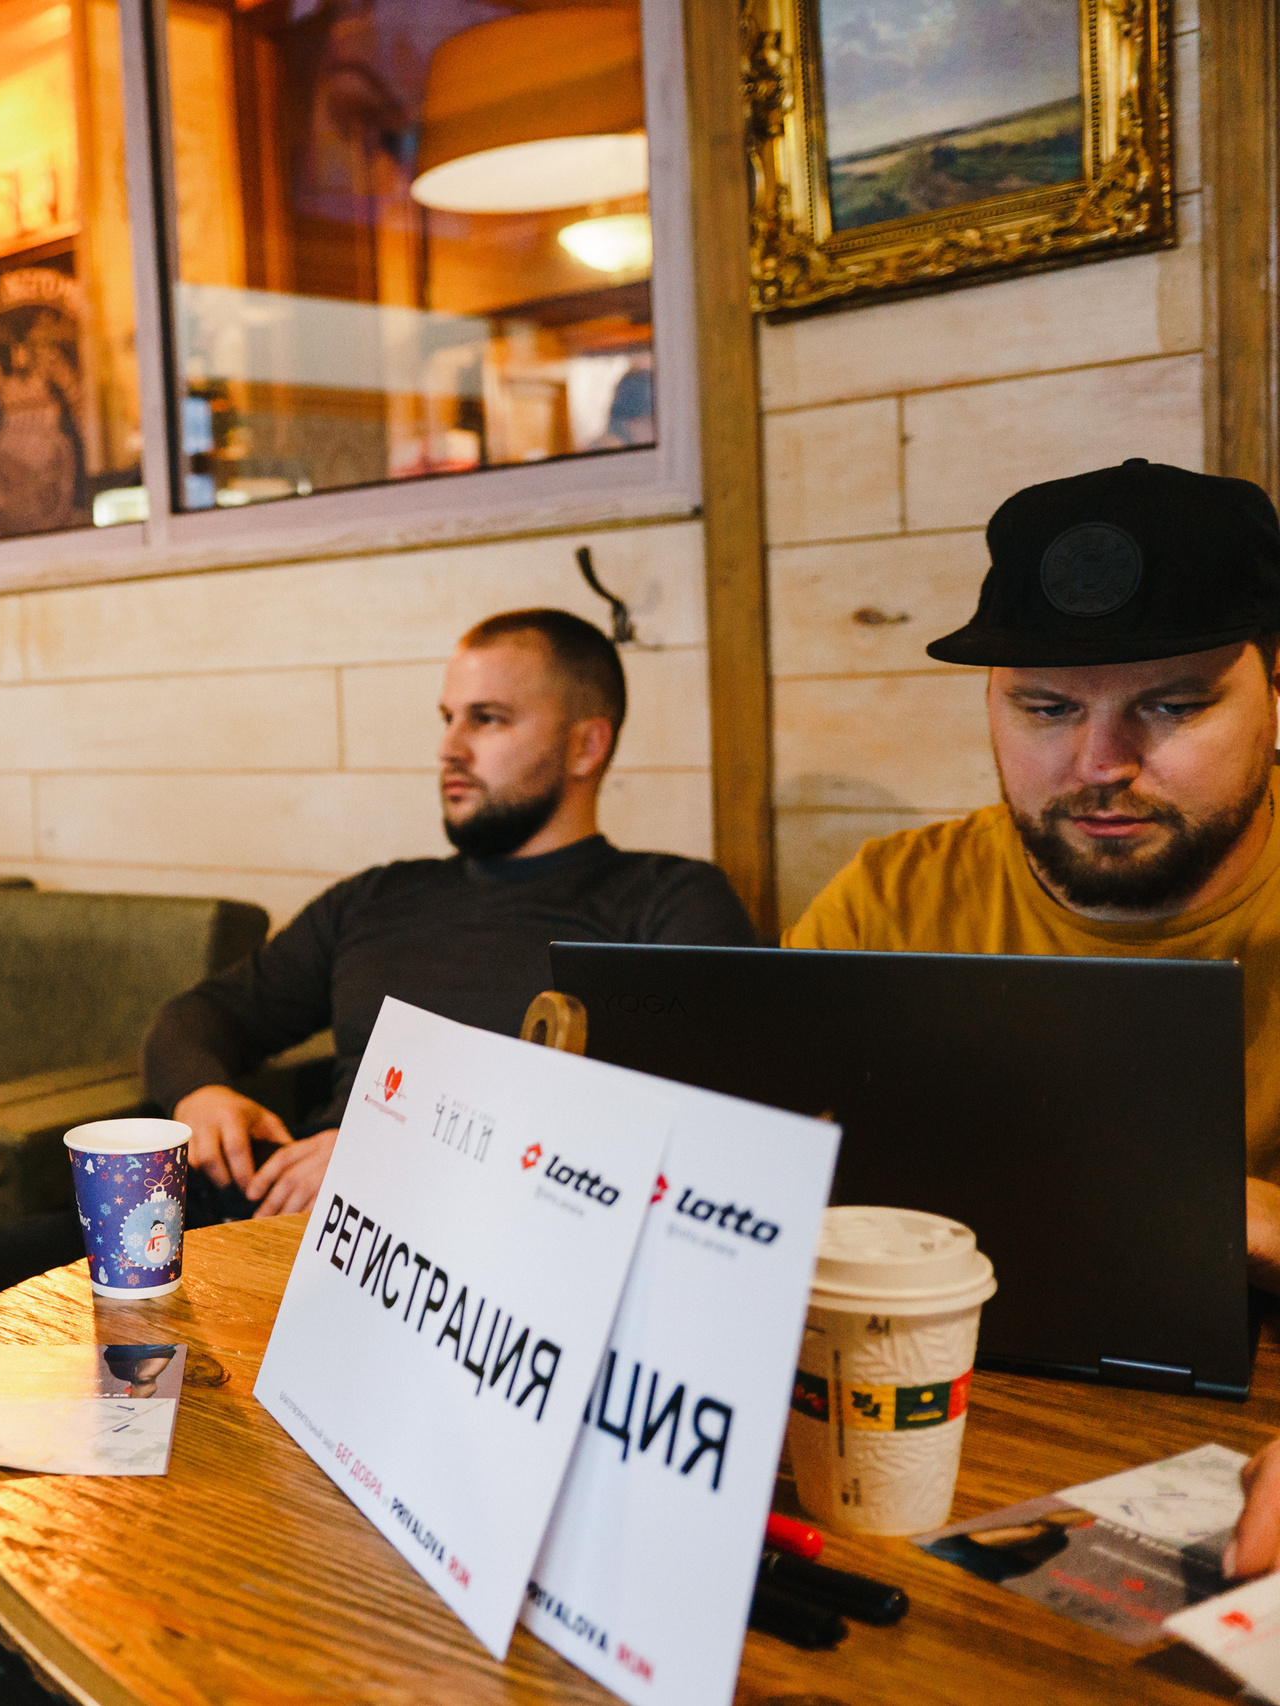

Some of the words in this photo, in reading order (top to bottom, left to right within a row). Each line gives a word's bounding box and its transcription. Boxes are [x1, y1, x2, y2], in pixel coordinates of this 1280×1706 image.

[597, 991, 688, 1015] YOGA
[316, 1193, 562, 1423] РЕГИСТРАЦИЯ
[335, 1442, 354, 1466] БЕГ
[349, 1459, 382, 1498] ДОБРА
[583, 1351, 733, 1491] ЦИЯ
